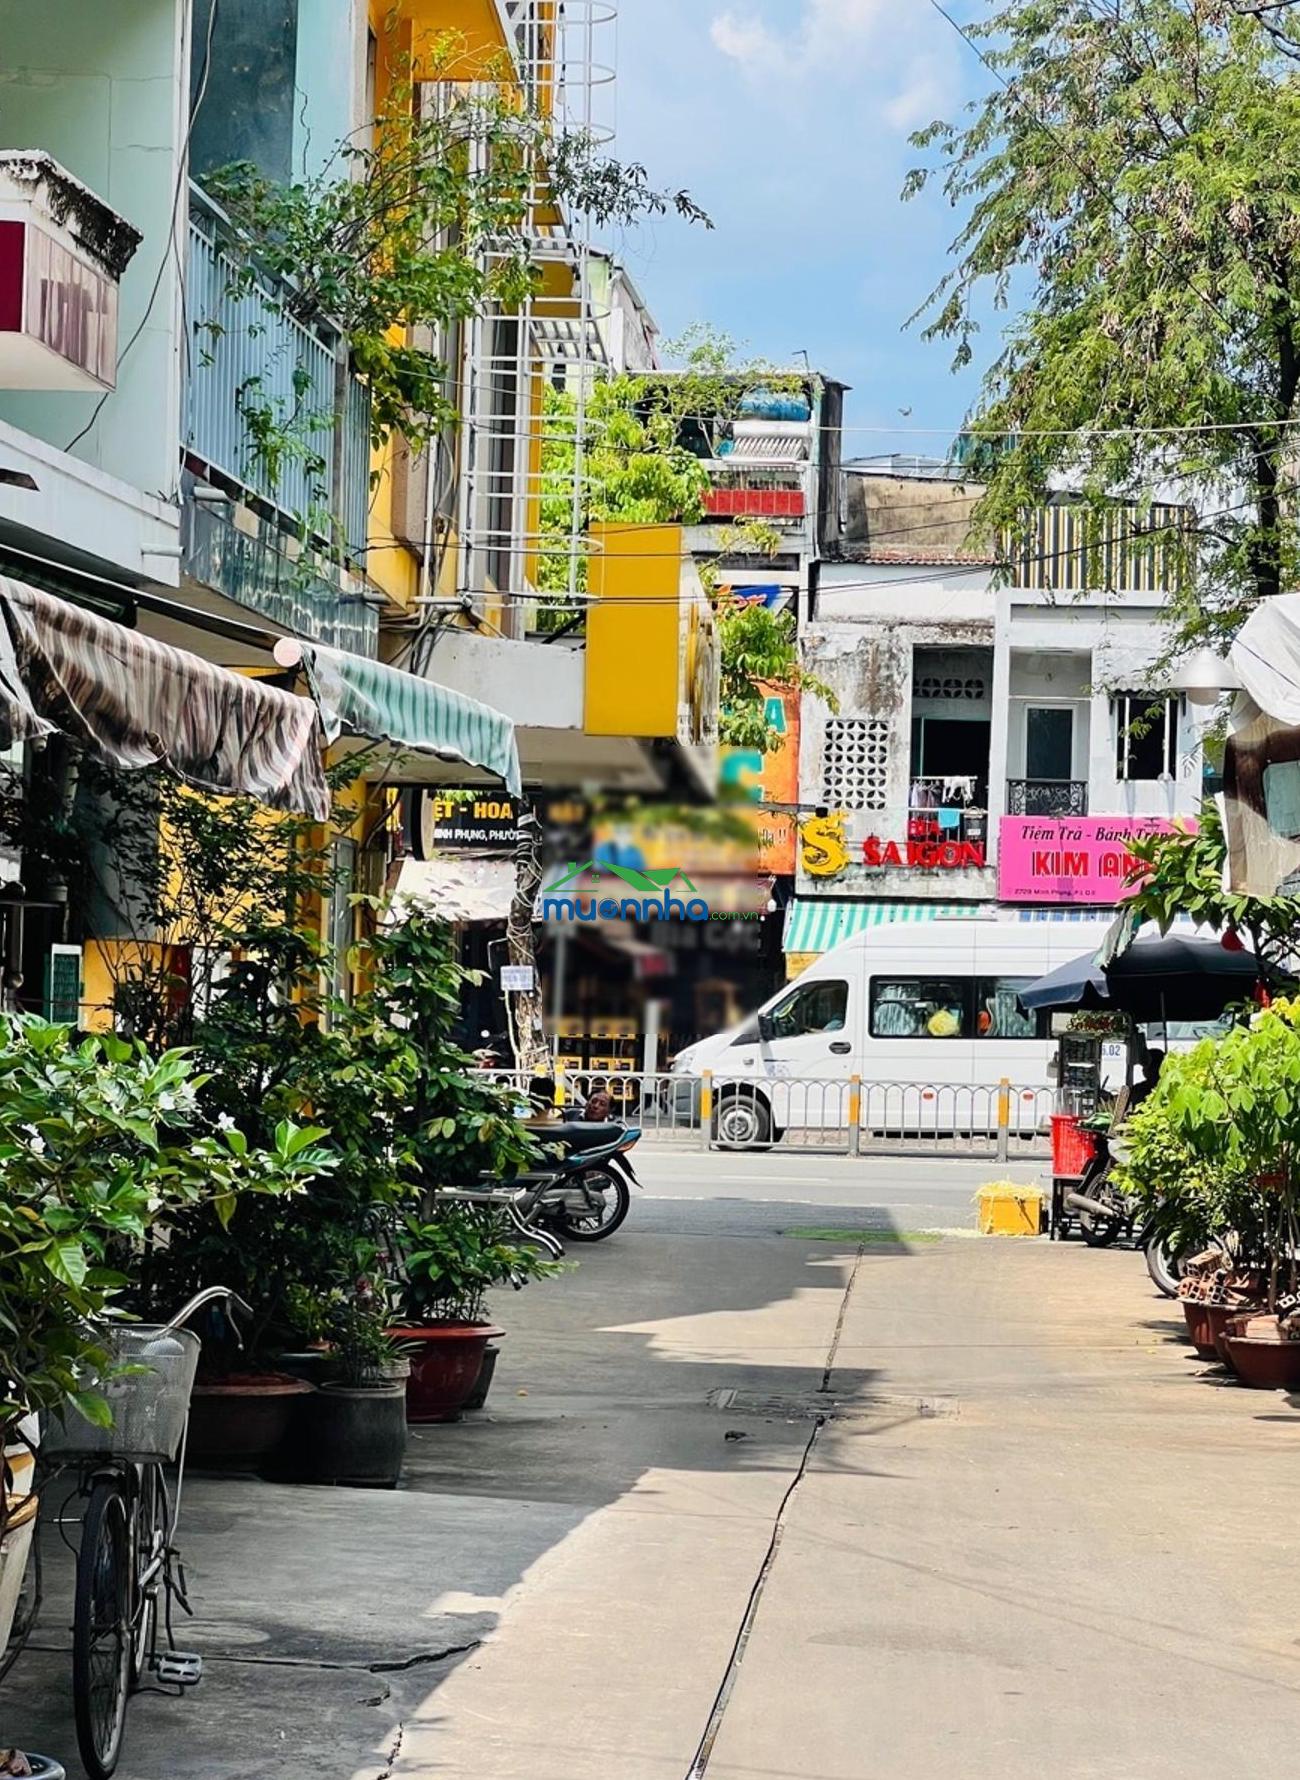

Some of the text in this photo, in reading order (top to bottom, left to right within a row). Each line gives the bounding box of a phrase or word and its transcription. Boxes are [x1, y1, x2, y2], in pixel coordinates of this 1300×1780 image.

[474, 802, 514, 819] HOA
[863, 836, 986, 868] SAIGON
[1032, 851, 1089, 877] KIM
